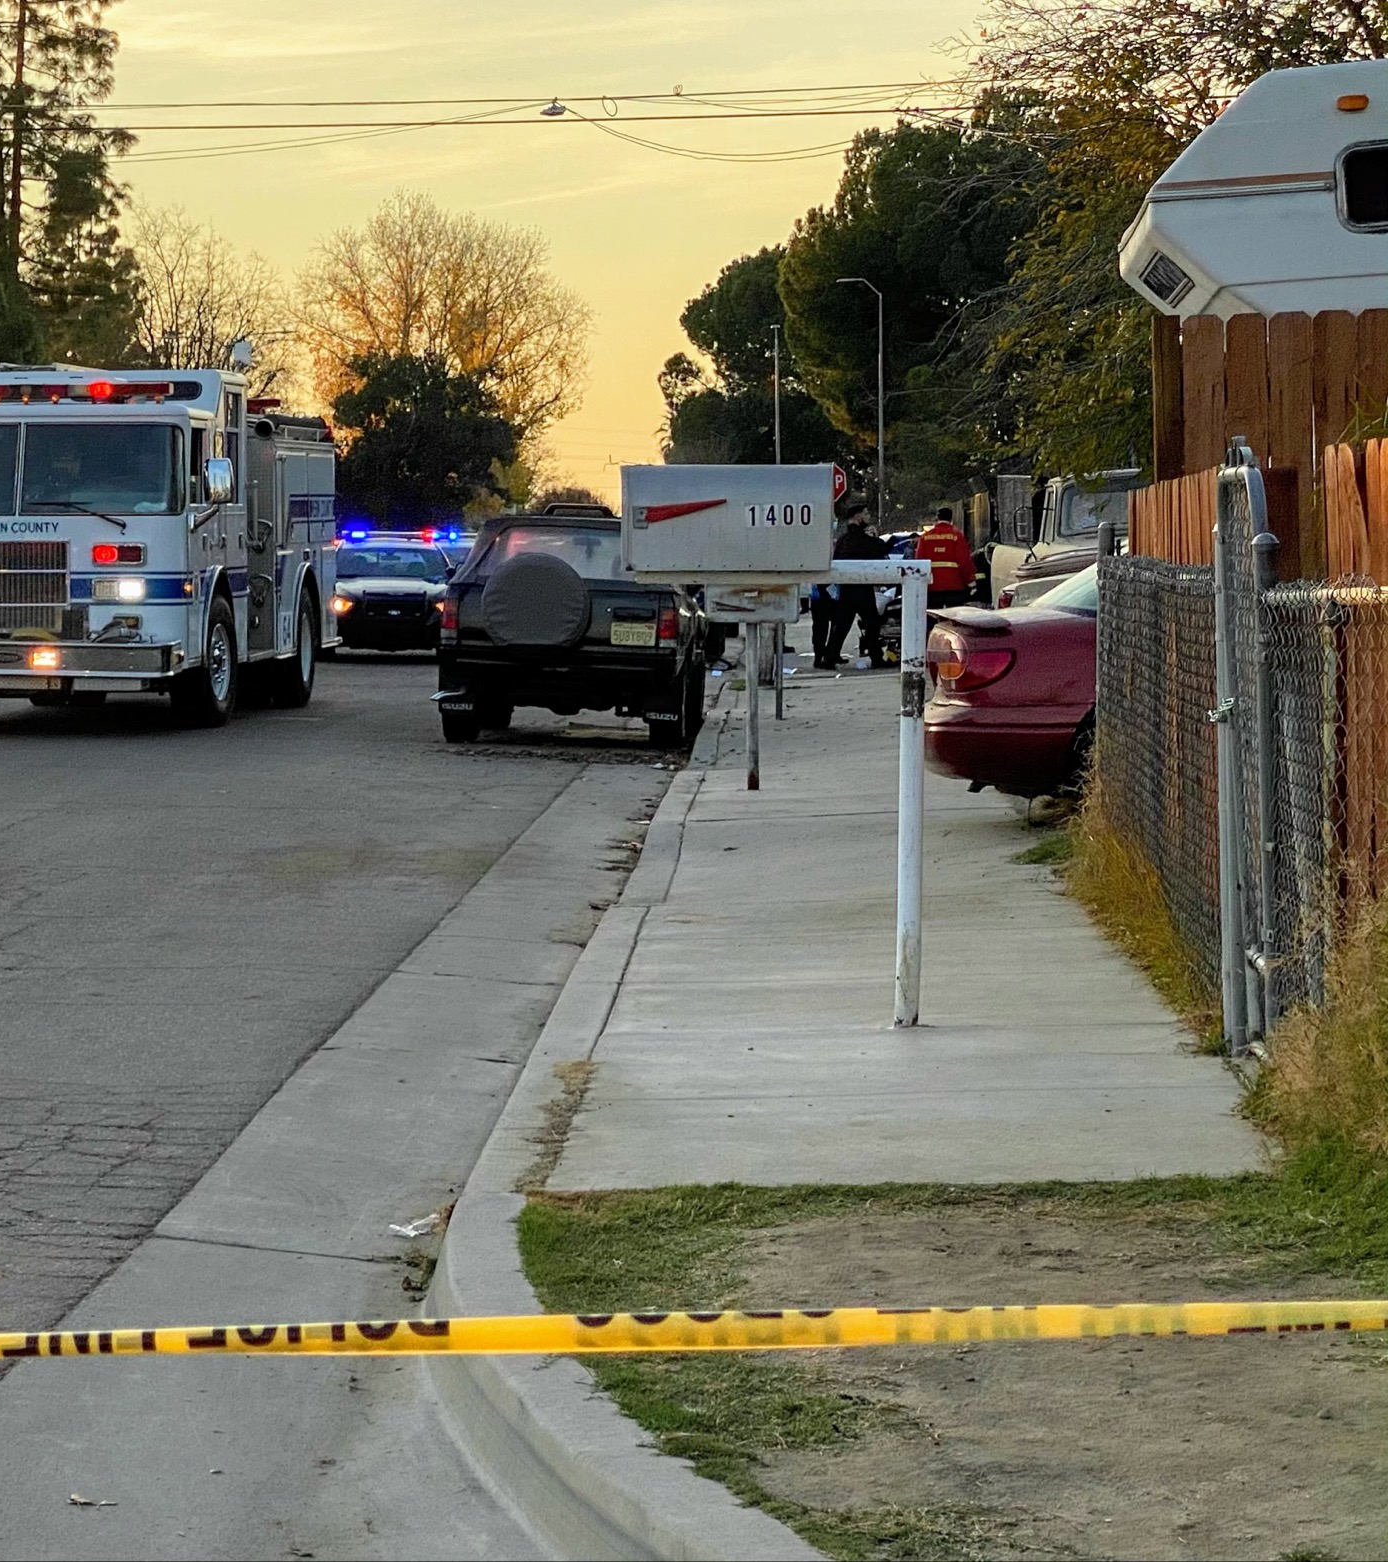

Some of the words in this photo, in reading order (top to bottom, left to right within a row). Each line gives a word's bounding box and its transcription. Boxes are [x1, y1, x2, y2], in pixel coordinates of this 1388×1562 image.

[748, 504, 811, 526] 1400
[10, 522, 60, 534] COUNTY
[441, 703, 474, 711] ISUZU
[646, 712, 679, 721] ISUZU
